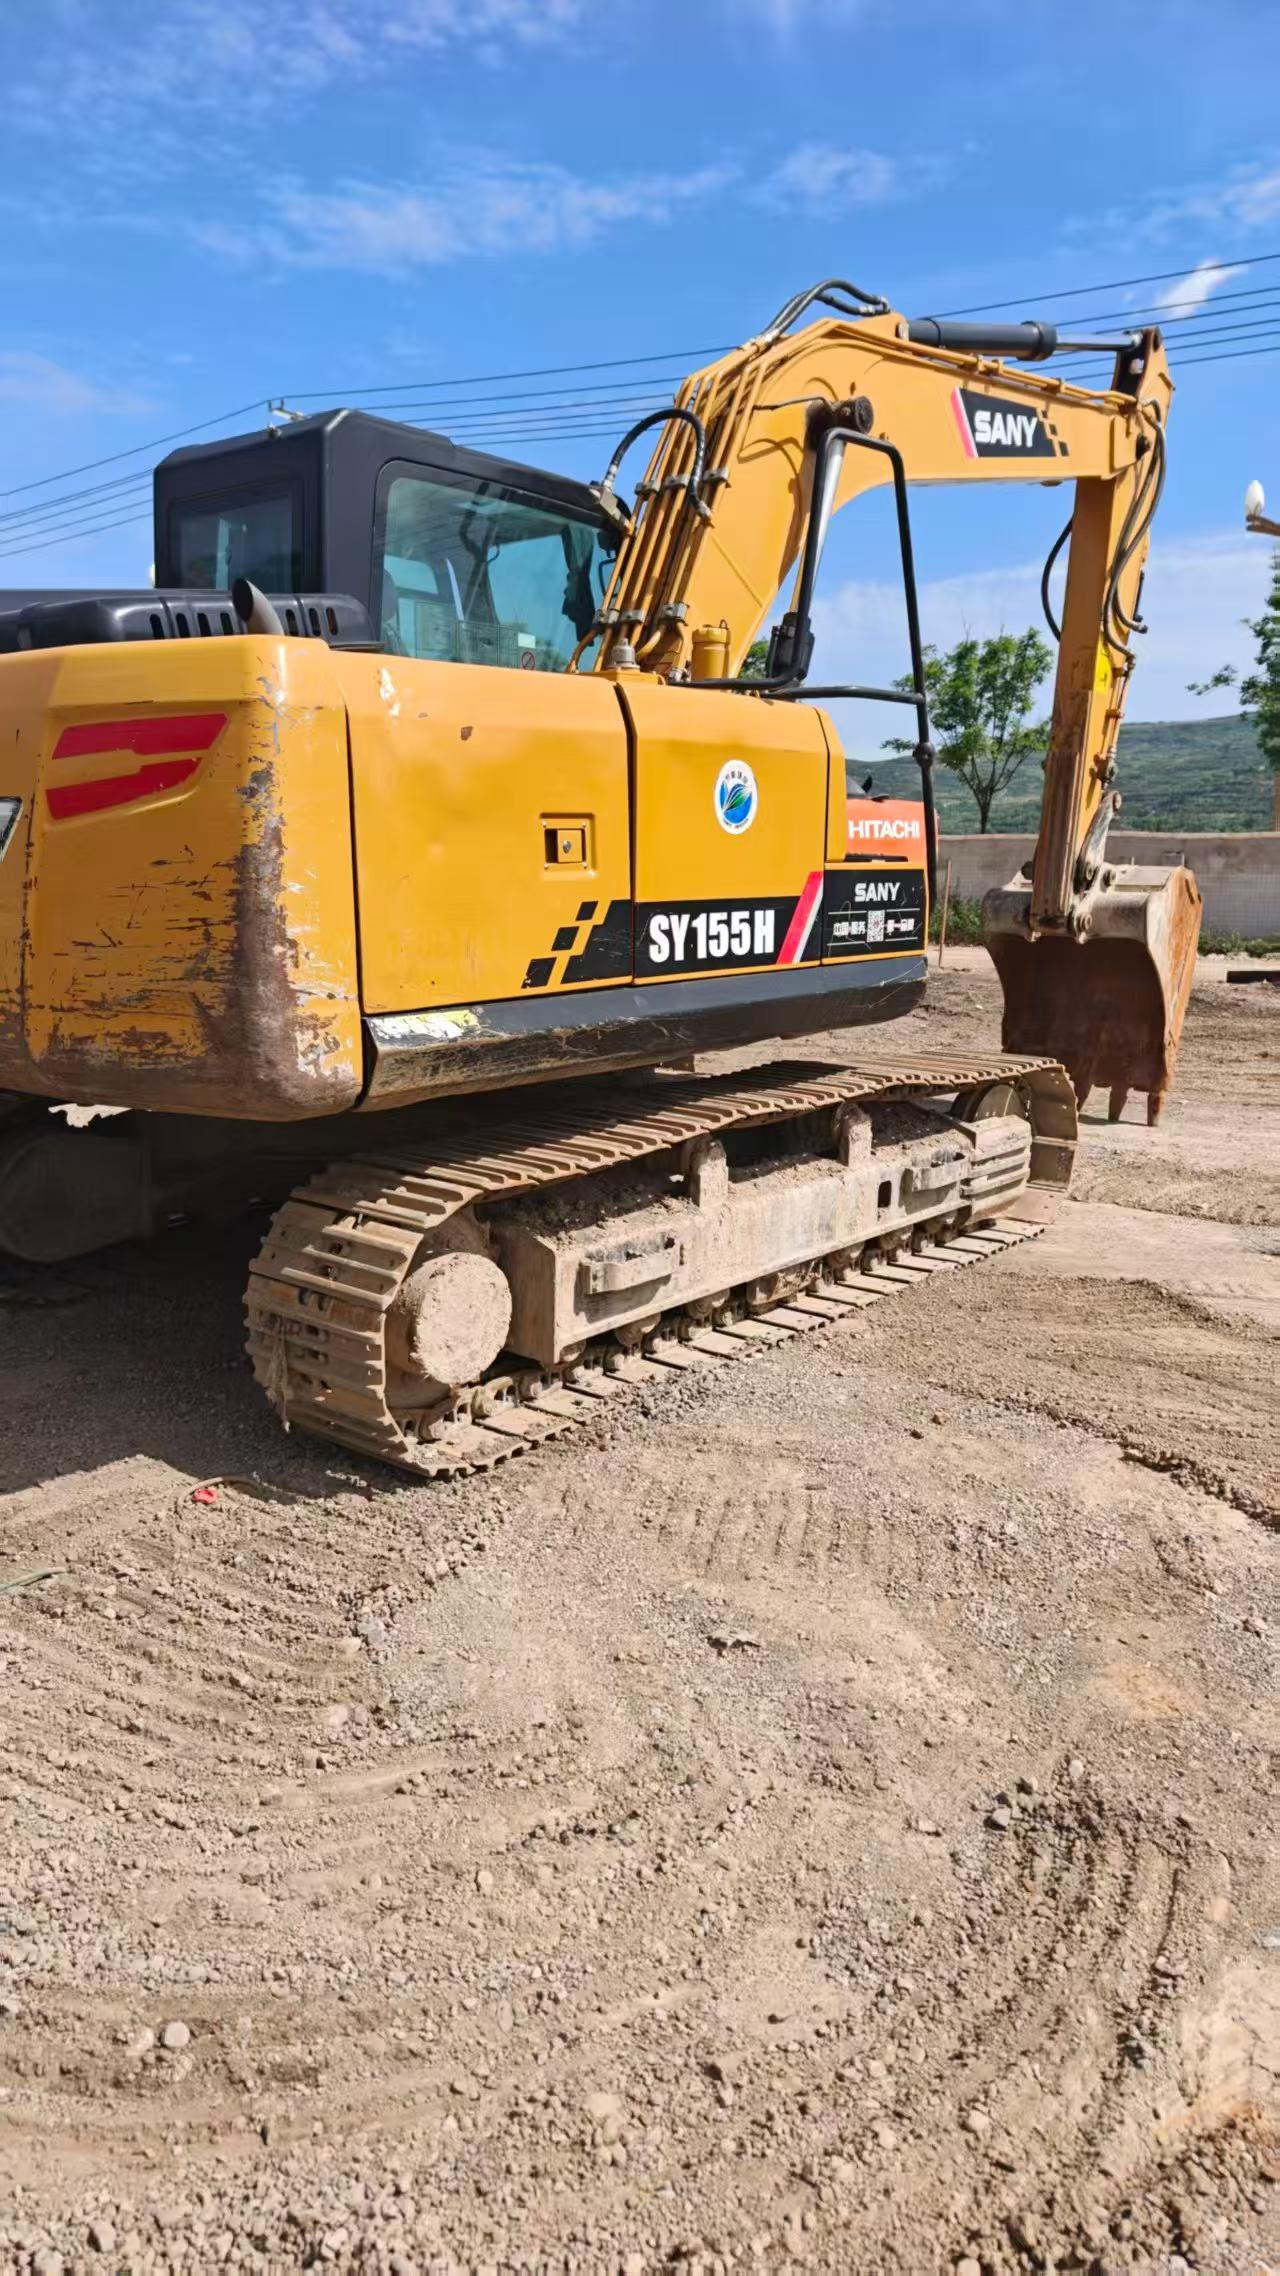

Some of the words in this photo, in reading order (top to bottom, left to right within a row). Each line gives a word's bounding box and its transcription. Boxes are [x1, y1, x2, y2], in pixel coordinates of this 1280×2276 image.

[975, 410, 1038, 448] SANY
[848, 820, 920, 839] HITACHI
[854, 883, 901, 902] SANY
[649, 909, 775, 963] SY155H
